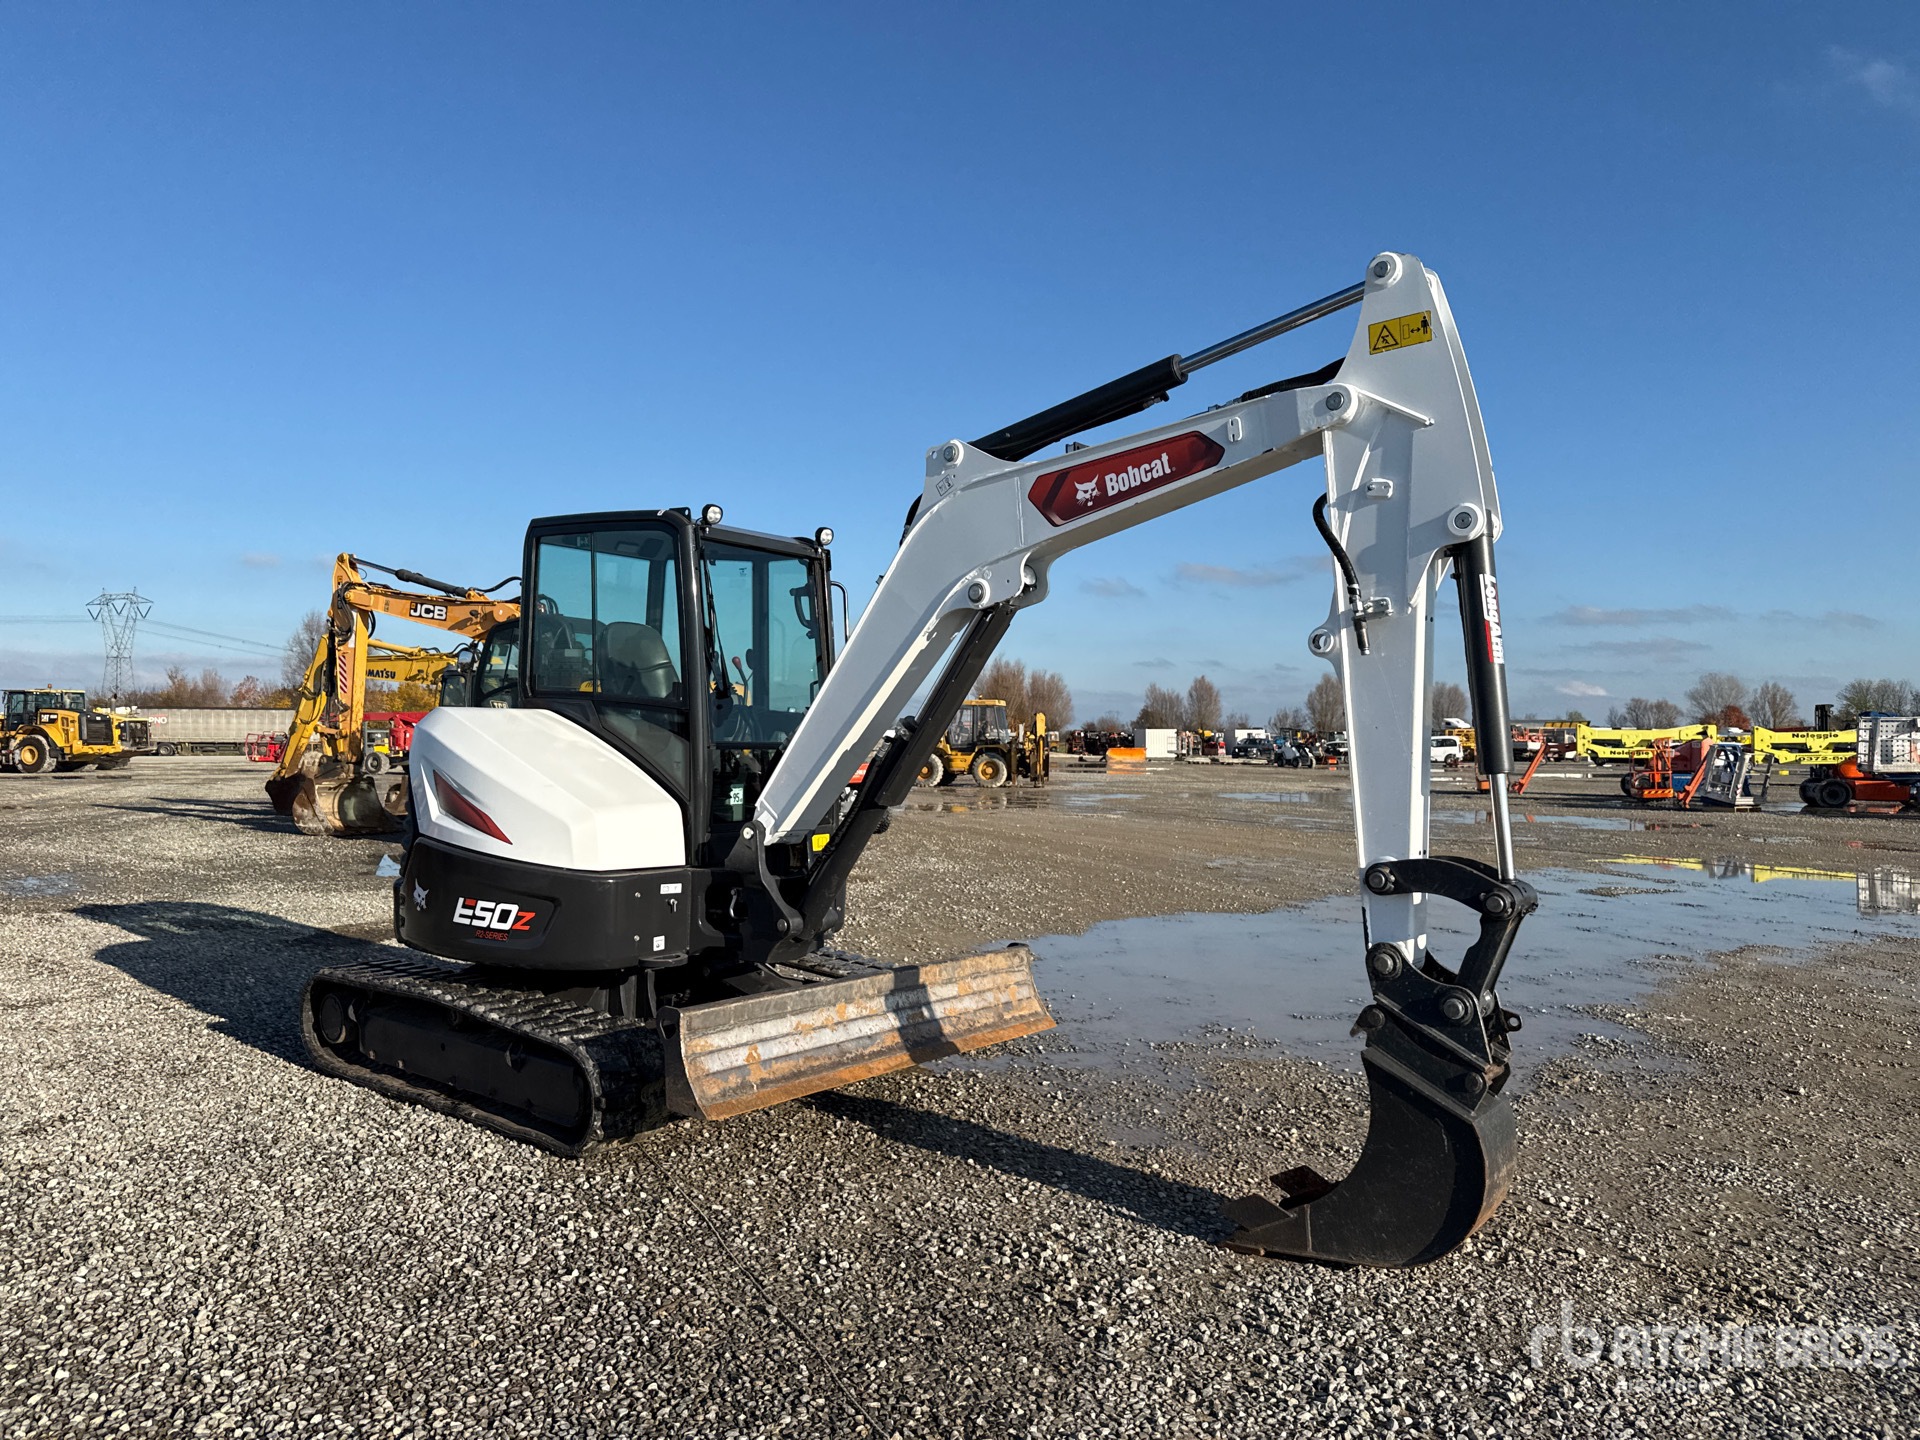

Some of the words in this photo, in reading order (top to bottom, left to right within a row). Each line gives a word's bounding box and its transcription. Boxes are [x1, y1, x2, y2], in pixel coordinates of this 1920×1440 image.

[1104, 451, 1172, 497] Bobcat
[410, 603, 447, 620] JCB
[366, 668, 396, 679] MATSU
[475, 929, 509, 942] R2-SERIES
